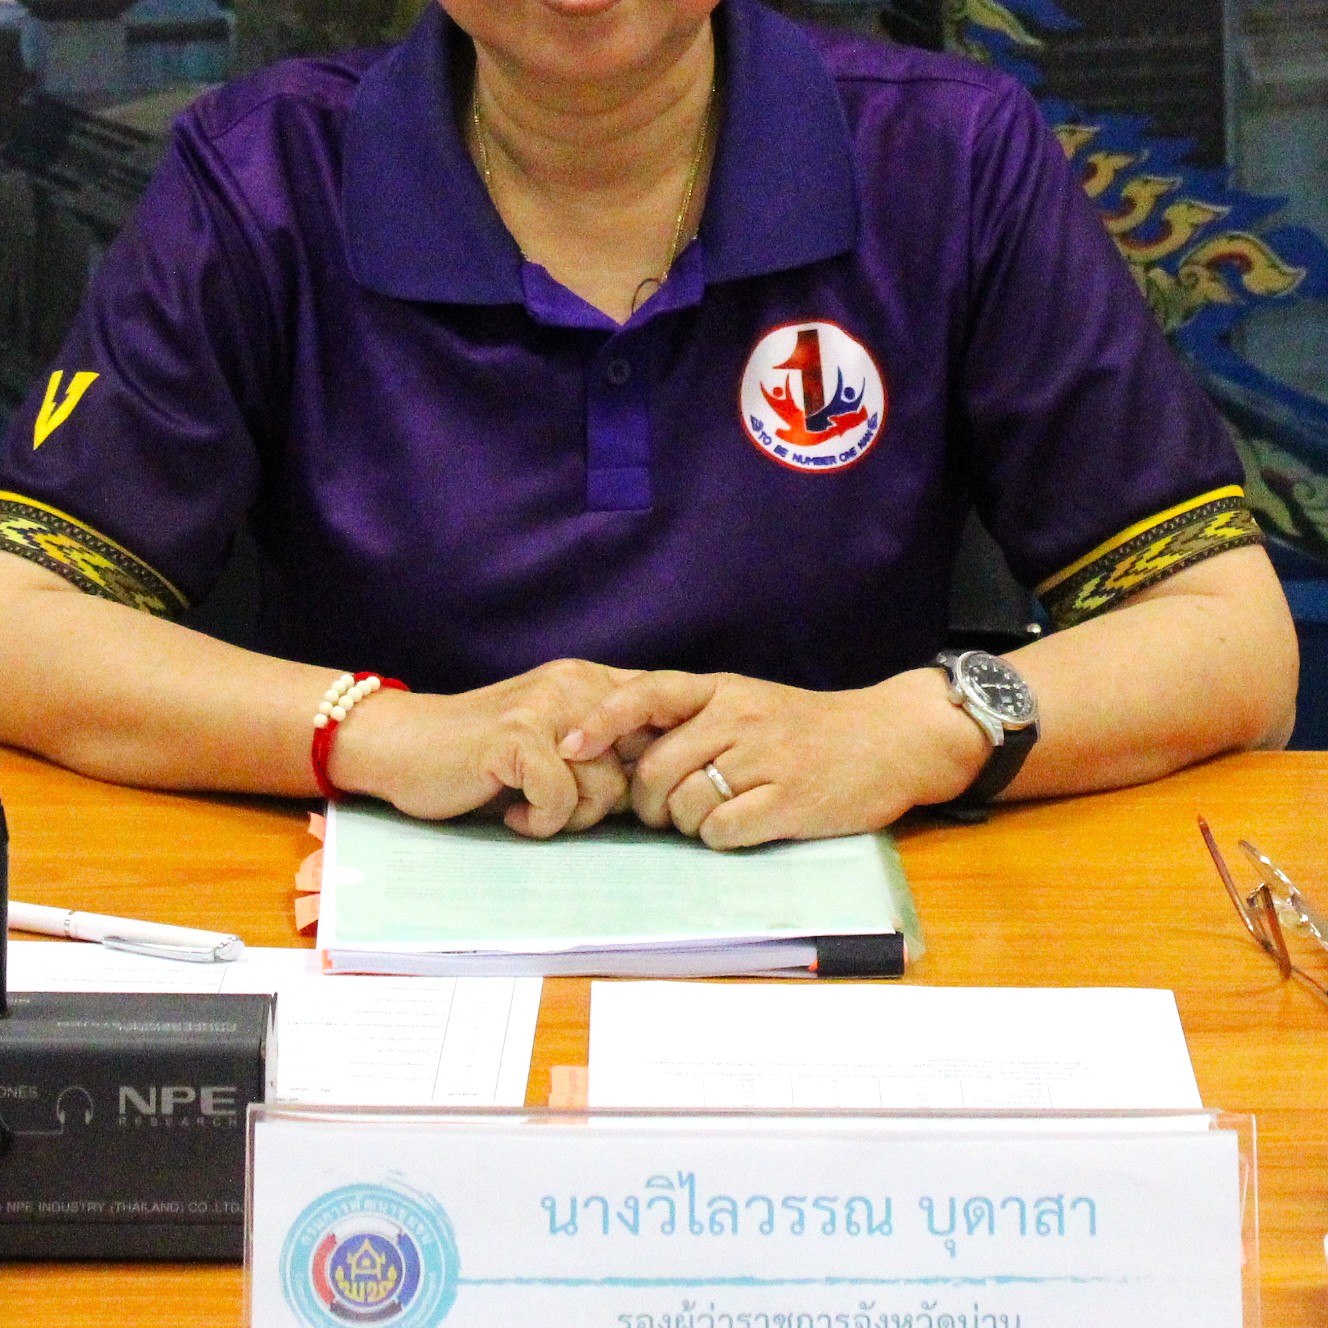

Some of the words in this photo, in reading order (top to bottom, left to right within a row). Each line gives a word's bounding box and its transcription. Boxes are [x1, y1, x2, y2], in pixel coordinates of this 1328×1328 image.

[758, 431, 772, 446] TO
[773, 444, 789, 458] BE
[792, 452, 837, 466] NUMBER
[838, 446, 858, 462] ONE
[118, 1085, 237, 1116] NPE
[7, 1202, 32, 1213] NPE
[38, 1202, 104, 1213] INDUSTRY
[540, 1170, 894, 1238] นางวิไลวรรณ
[918, 1193, 1098, 1258] บุดาสา
